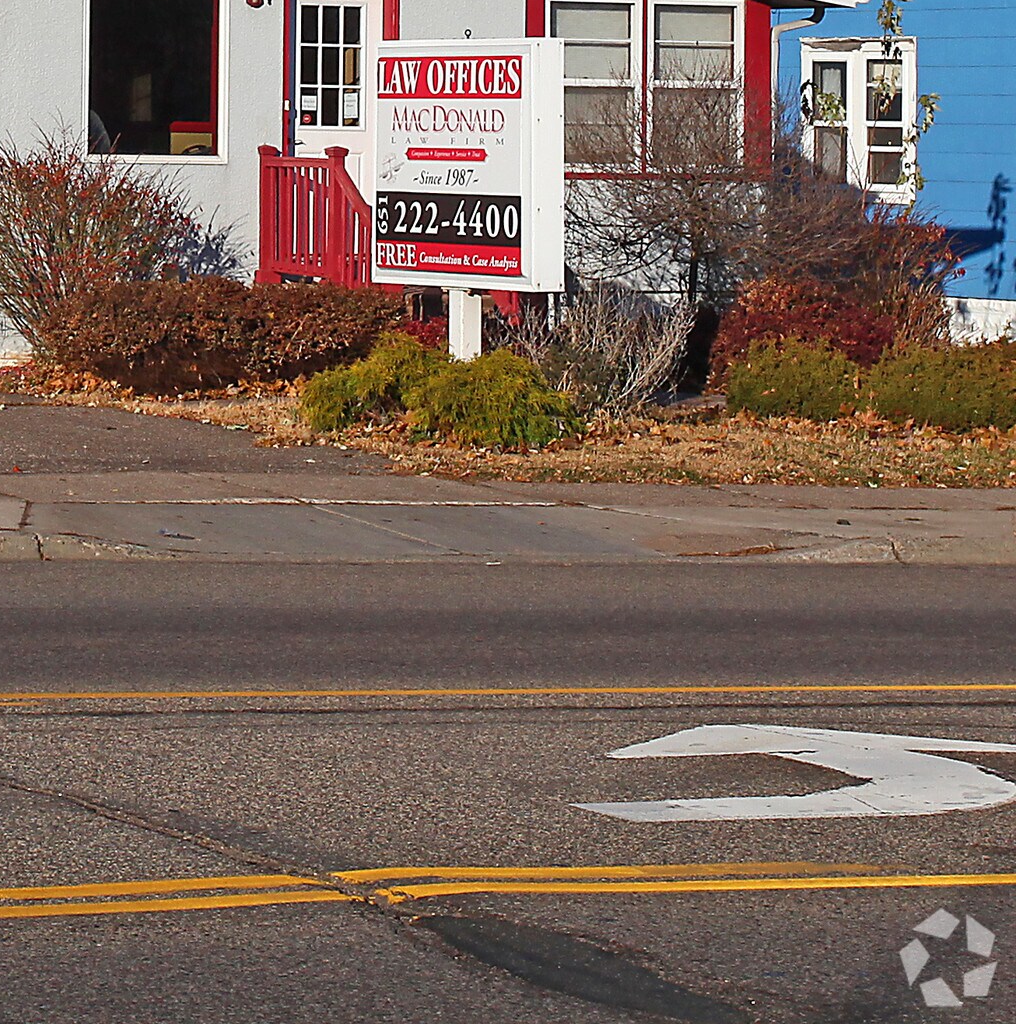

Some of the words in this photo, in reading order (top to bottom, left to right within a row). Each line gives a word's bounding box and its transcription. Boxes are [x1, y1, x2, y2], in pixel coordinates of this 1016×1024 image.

[378, 60, 421, 94] LAW
[427, 59, 520, 95] OFFICES
[391, 136, 429, 145] LAW
[450, 137, 504, 146] FIRM
[378, 195, 389, 234] 651
[394, 199, 519, 239] 222-4400
[376, 242, 417, 267] FREE
[419, 252, 462, 266] Consultation
[463, 255, 471, 266] &
[472, 255, 488, 267] Case
[489, 256, 519, 271] Analysis
